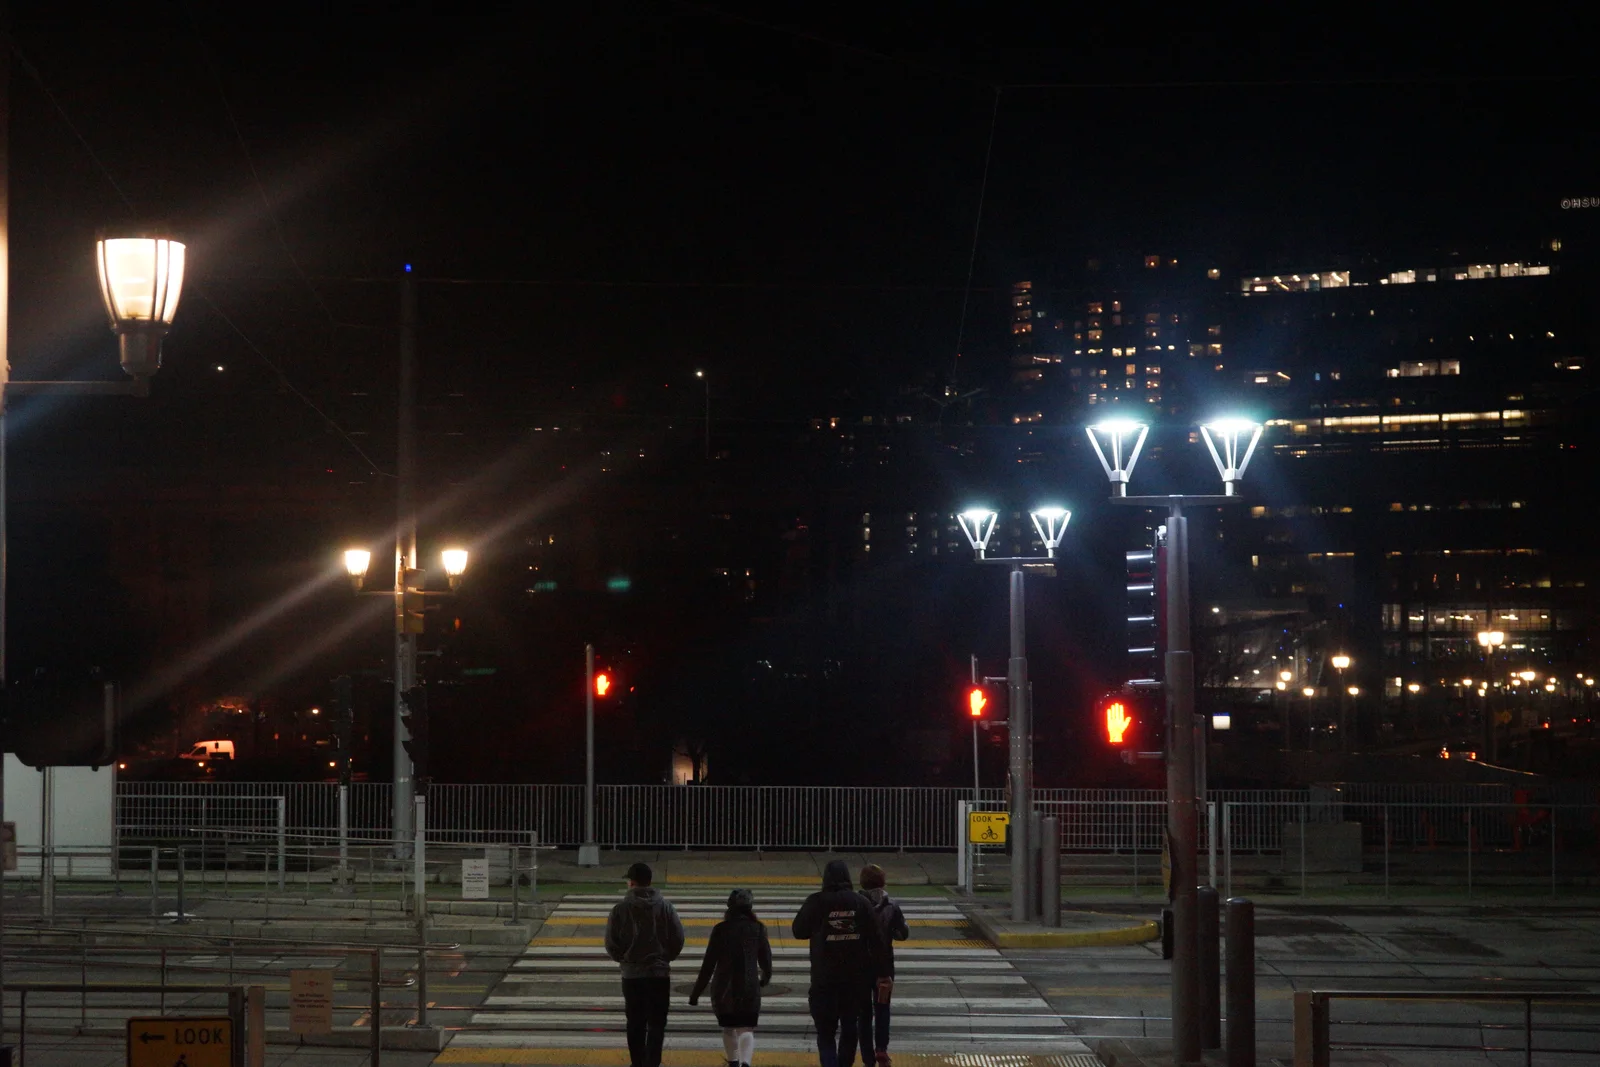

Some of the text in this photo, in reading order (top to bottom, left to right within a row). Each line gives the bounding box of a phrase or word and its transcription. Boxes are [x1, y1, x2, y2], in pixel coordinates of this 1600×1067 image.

[1560, 196, 1600, 209] OHSU
[972, 815, 993, 823] LOOK
[174, 1028, 224, 1045] LOOK
